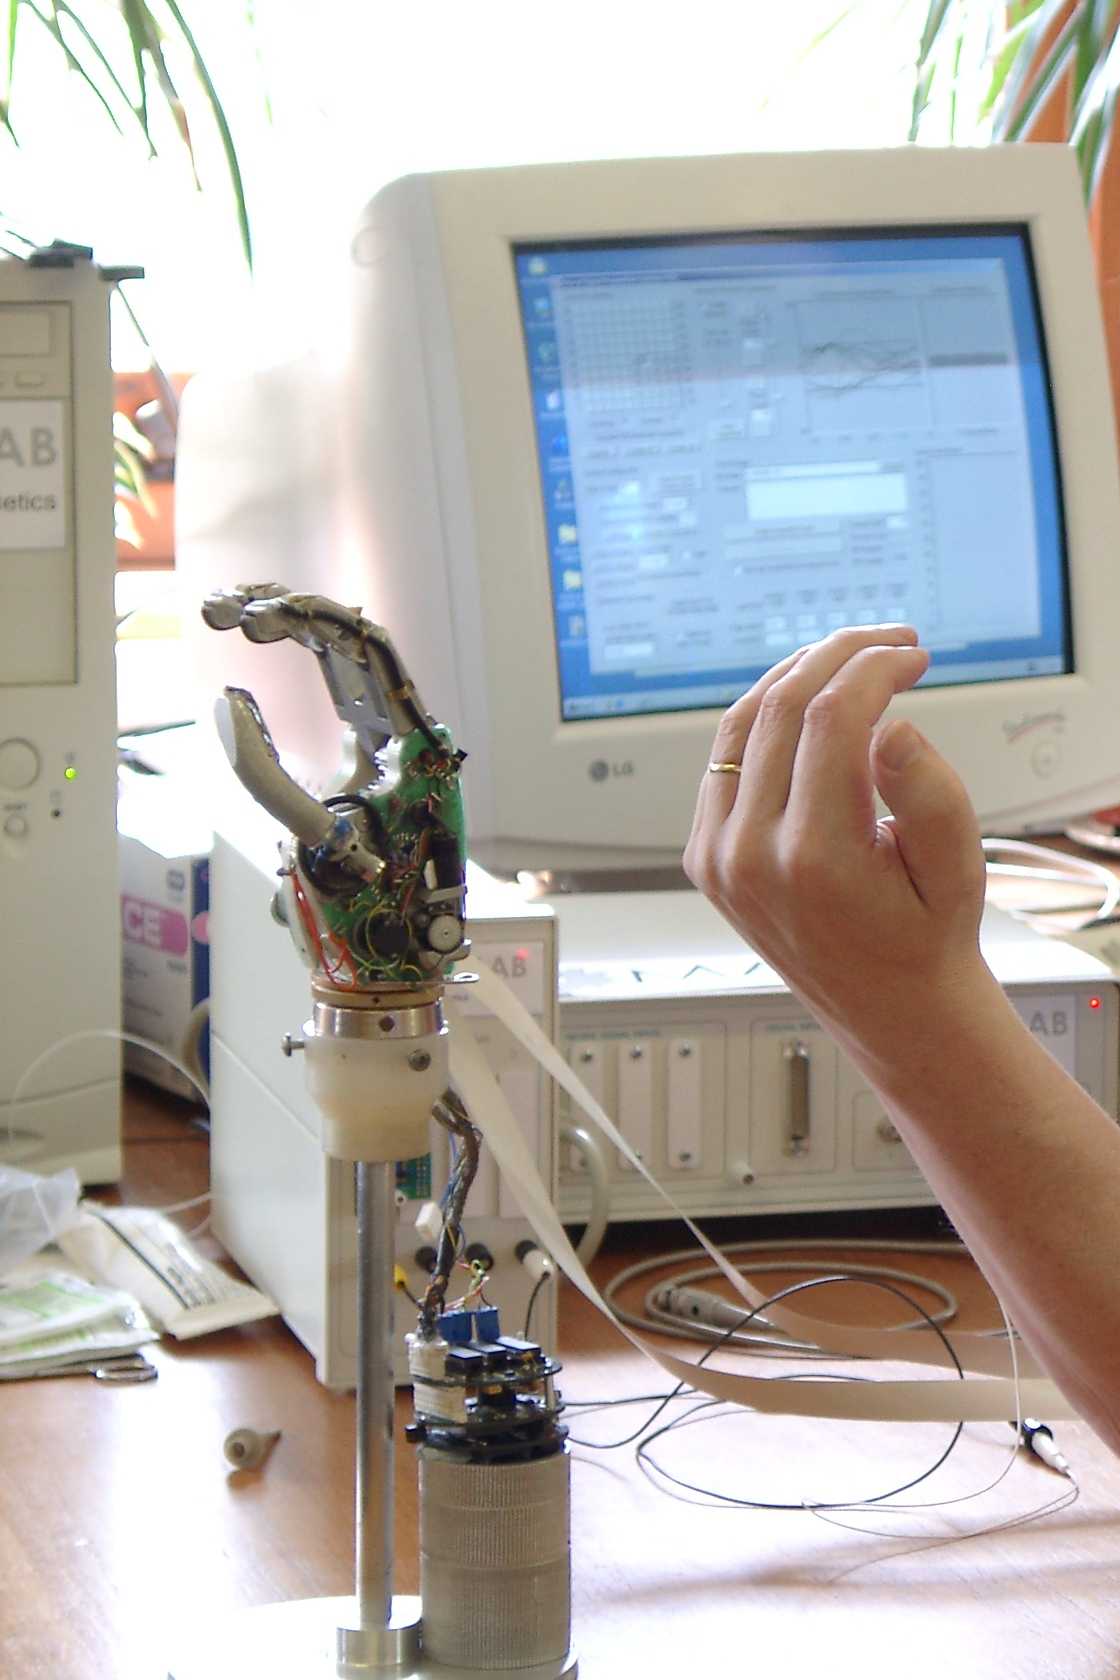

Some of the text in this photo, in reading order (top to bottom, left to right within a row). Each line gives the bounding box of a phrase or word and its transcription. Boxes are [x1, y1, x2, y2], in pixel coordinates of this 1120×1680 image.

[0, 427, 57, 468] AB
[612, 761, 635, 779] LG
[1030, 1011, 1068, 1036] AB
